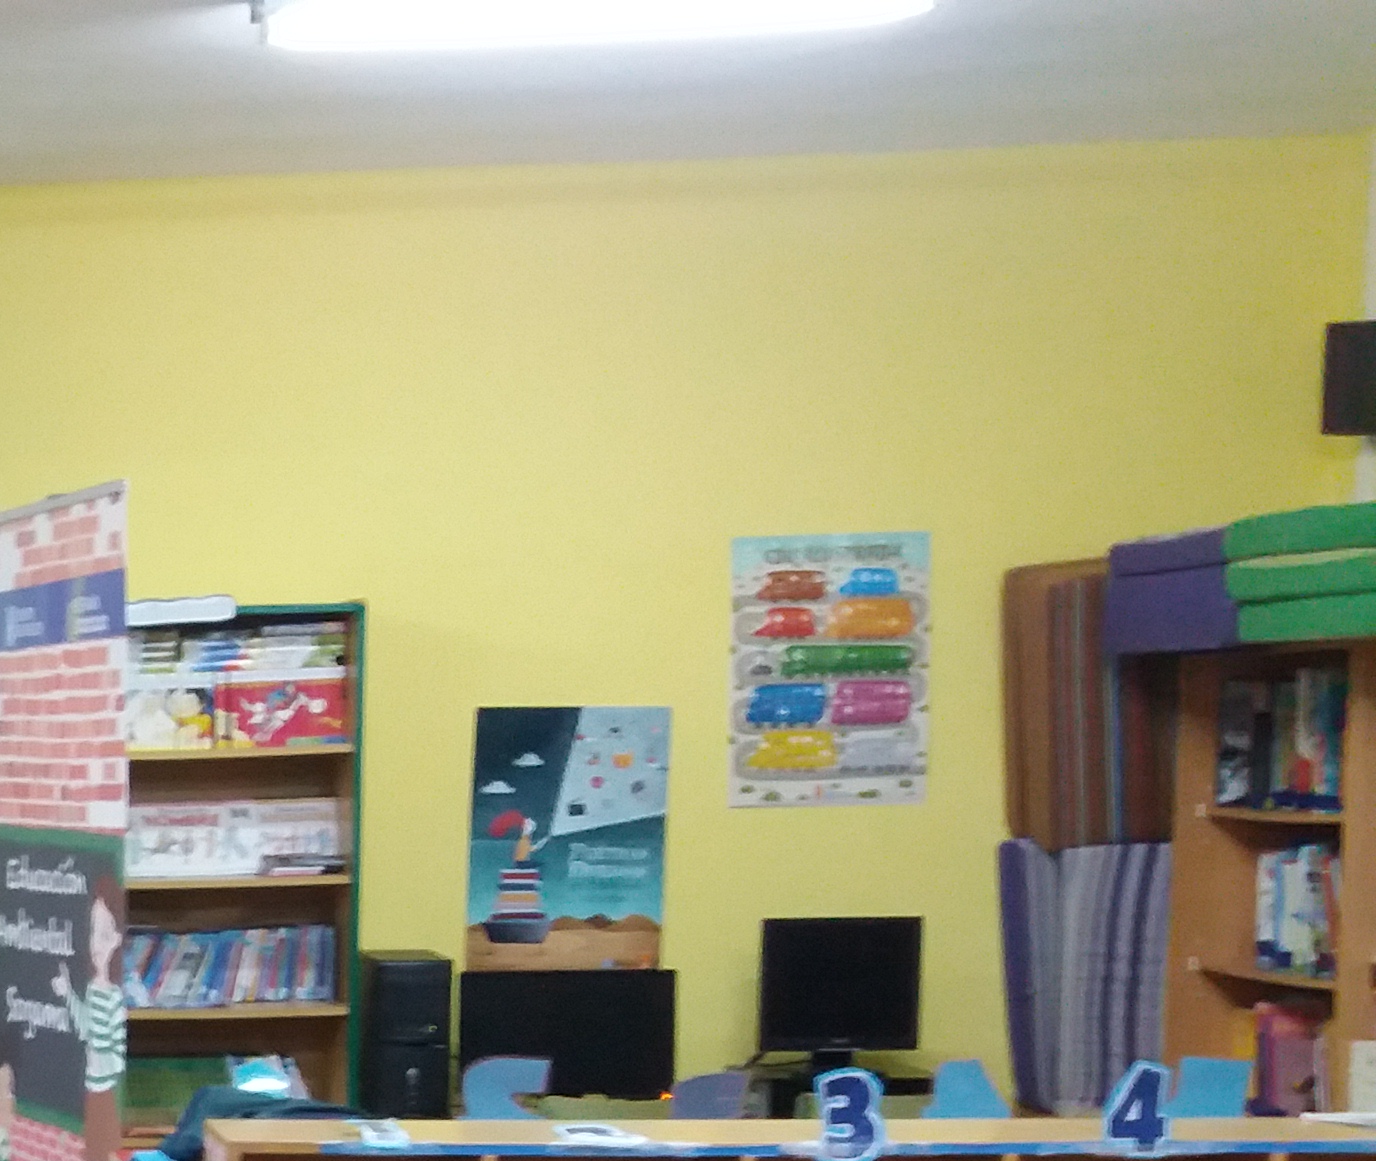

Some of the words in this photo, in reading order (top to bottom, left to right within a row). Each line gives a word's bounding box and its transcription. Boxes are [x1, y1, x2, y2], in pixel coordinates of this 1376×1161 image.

[6, 855, 88, 894] Educación
[822, 1073, 878, 1160] 3
[1109, 1065, 1166, 1152] 4
